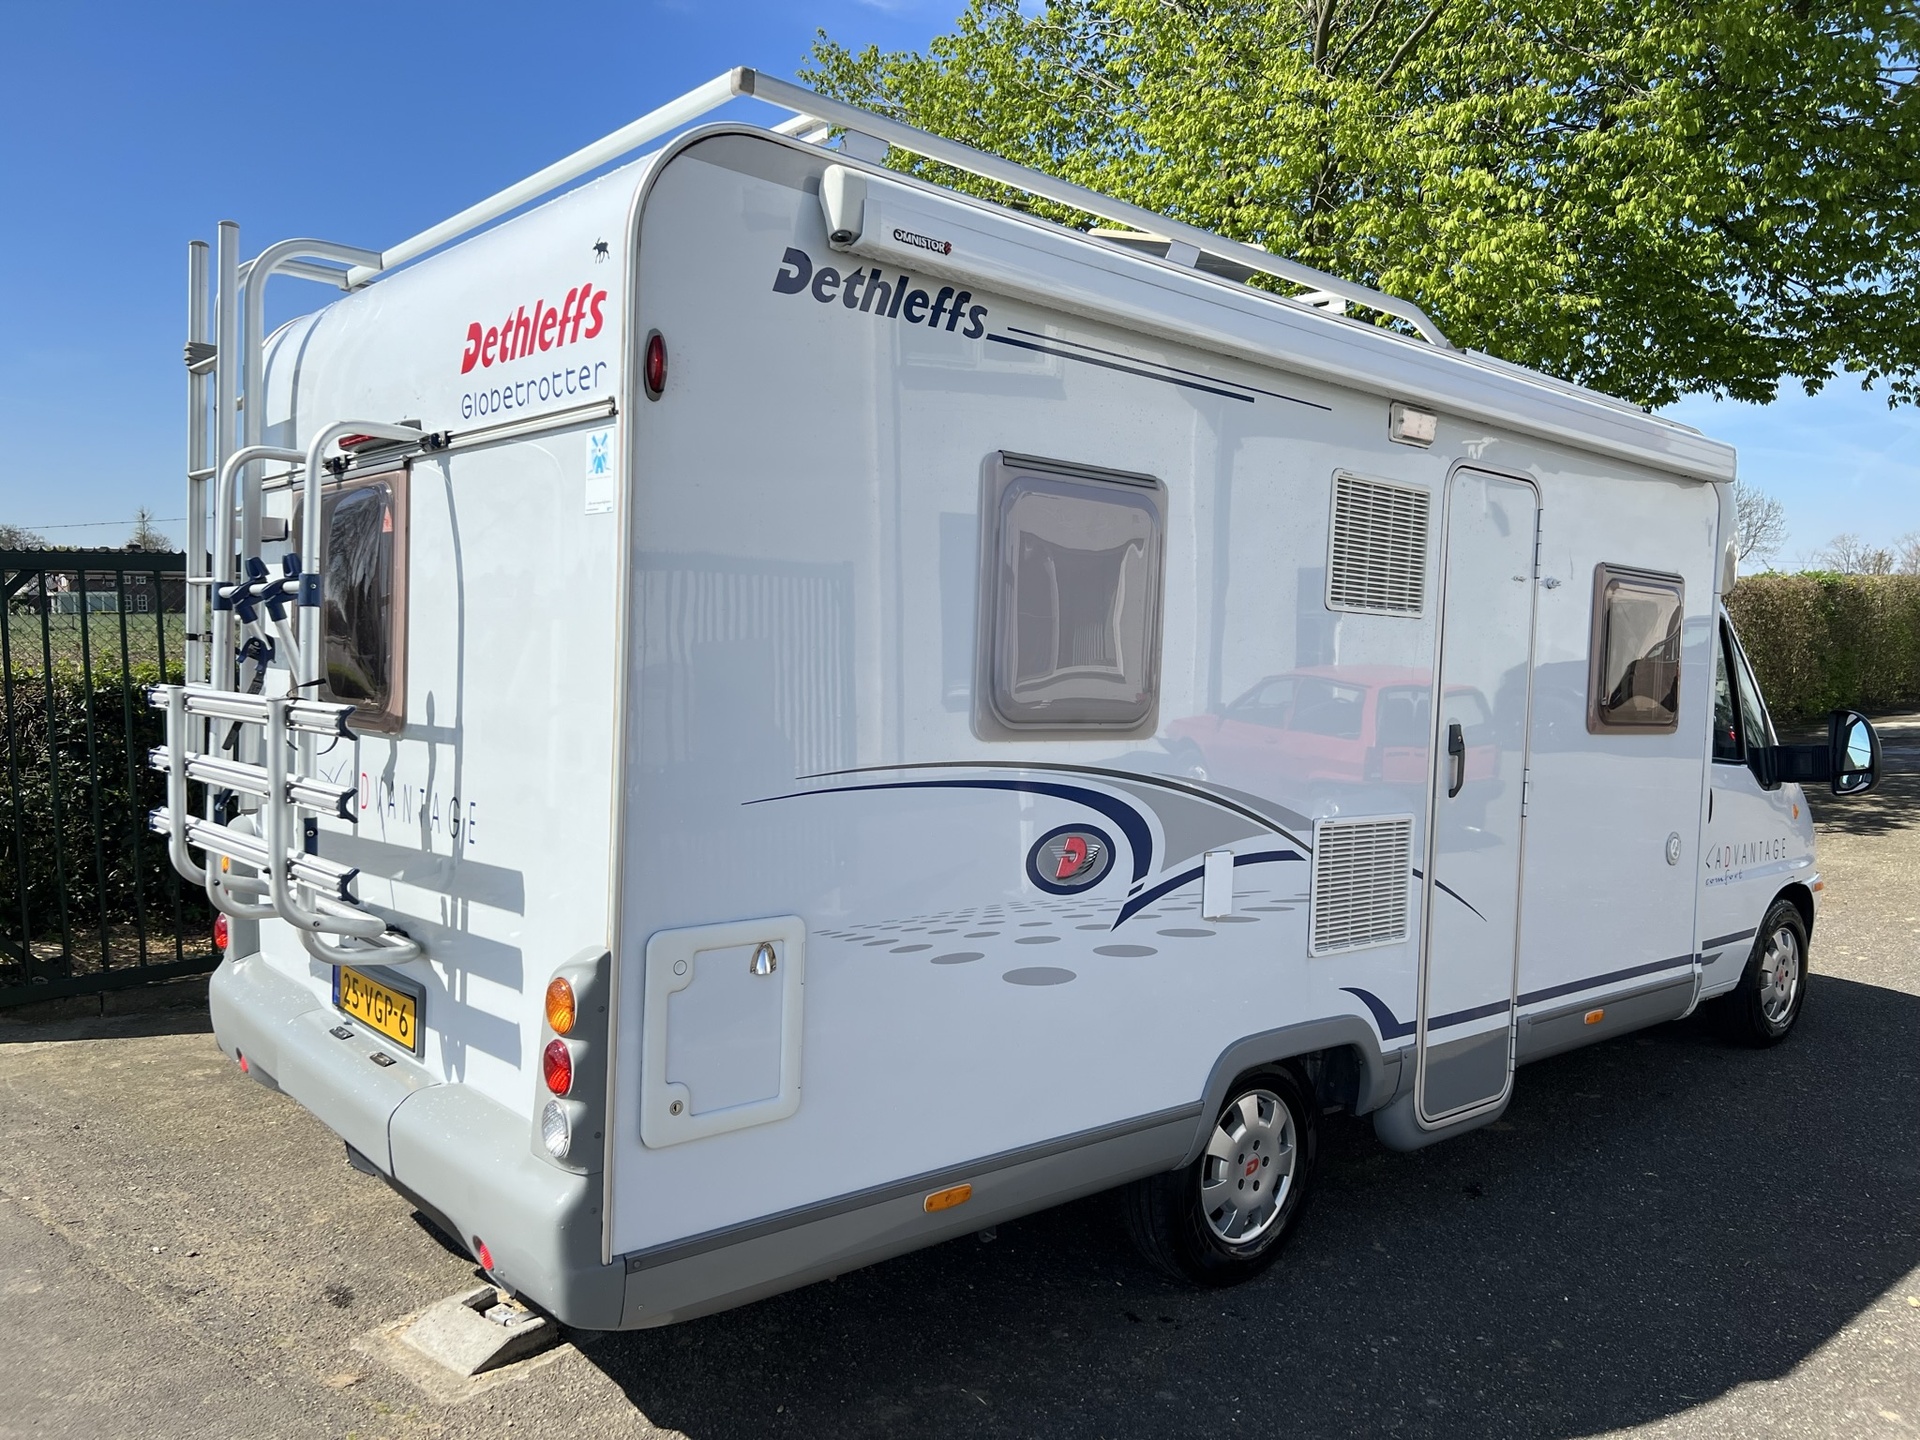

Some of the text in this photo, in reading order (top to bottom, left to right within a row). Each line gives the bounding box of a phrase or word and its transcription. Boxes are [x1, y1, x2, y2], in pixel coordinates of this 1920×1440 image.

[893, 229, 946, 254] OMNISTOR
[772, 247, 988, 339] Dethleffs
[461, 283, 607, 375] Dethleffs
[461, 361, 607, 419] Globetrotter
[1705, 869, 1743, 886] comfort
[1715, 837, 1786, 869] ADVANTAGE
[343, 973, 408, 1037] 25-VGP-6
